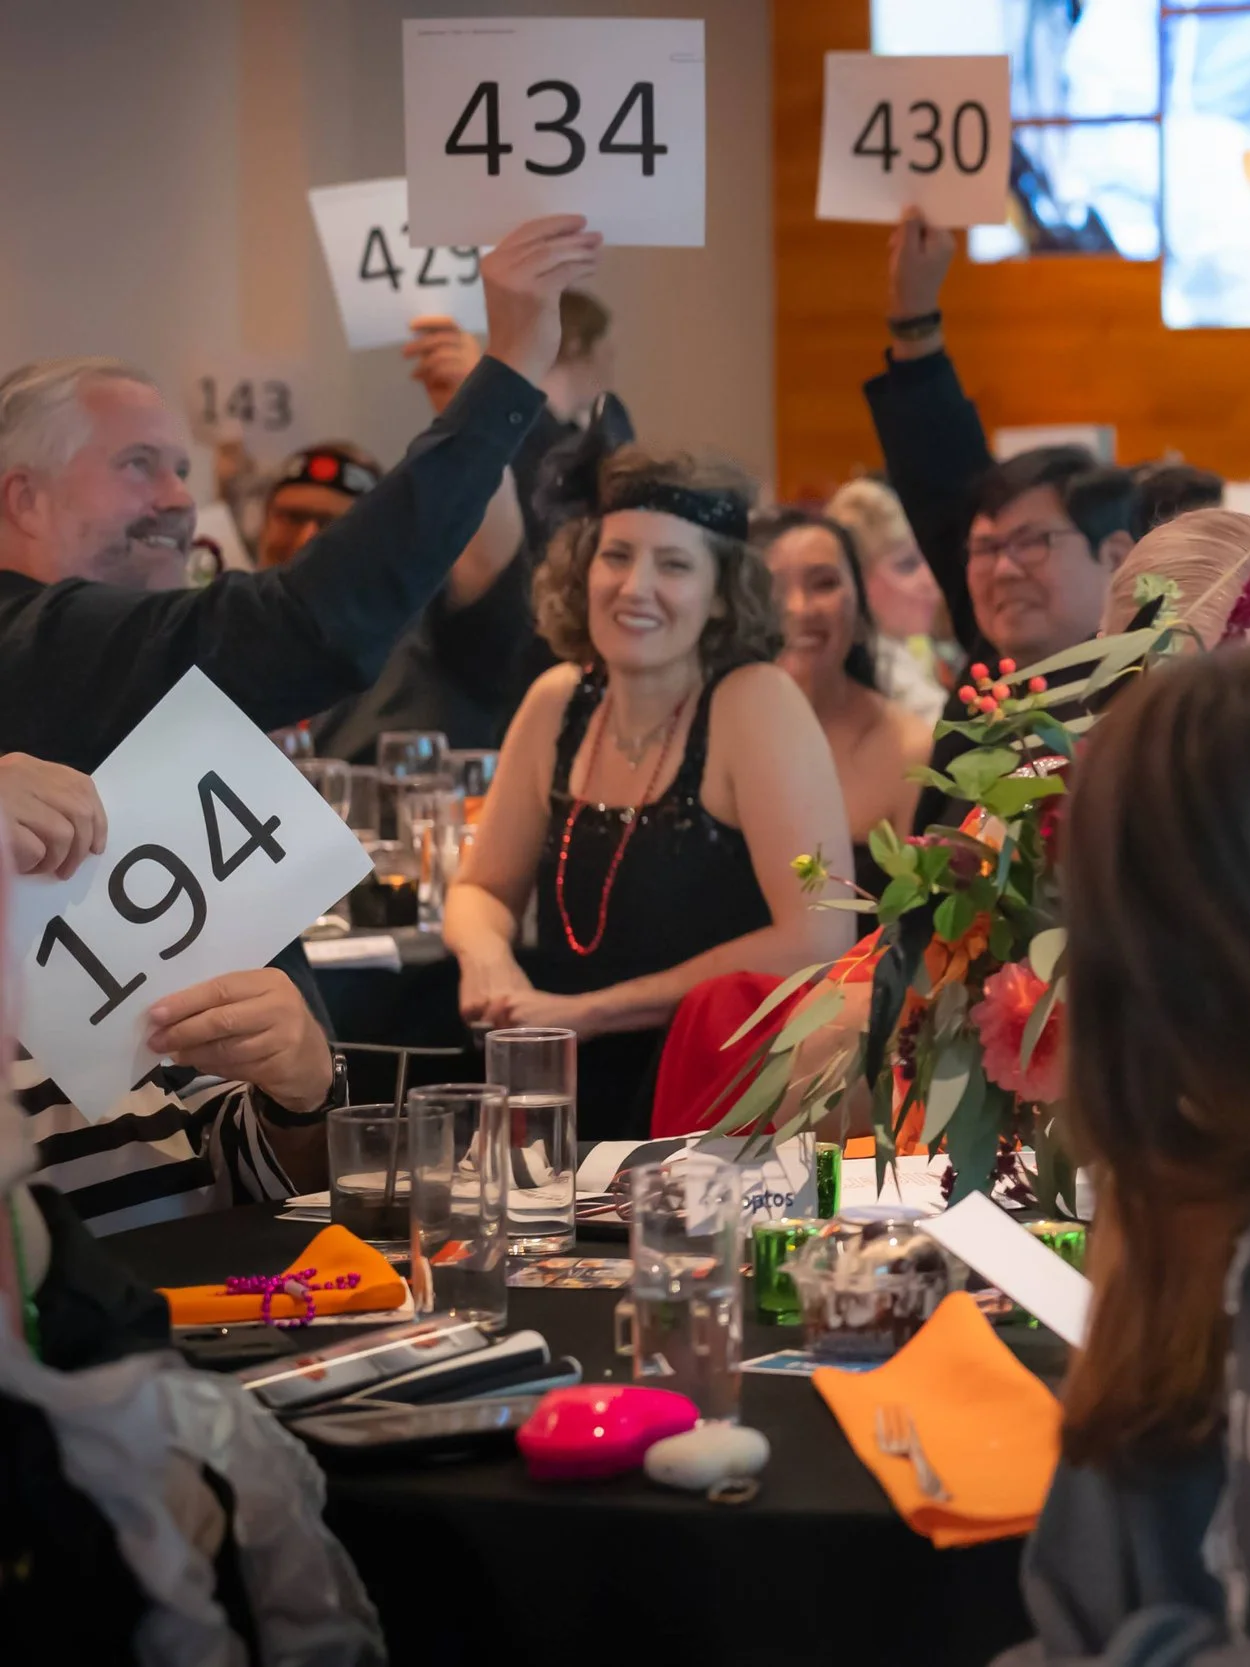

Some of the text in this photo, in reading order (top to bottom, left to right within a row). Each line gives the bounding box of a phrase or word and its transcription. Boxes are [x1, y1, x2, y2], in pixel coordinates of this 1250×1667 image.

[444, 79, 668, 177] 434
[852, 100, 990, 176] 430
[200, 377, 293, 432] 143
[35, 770, 287, 1026] 194
